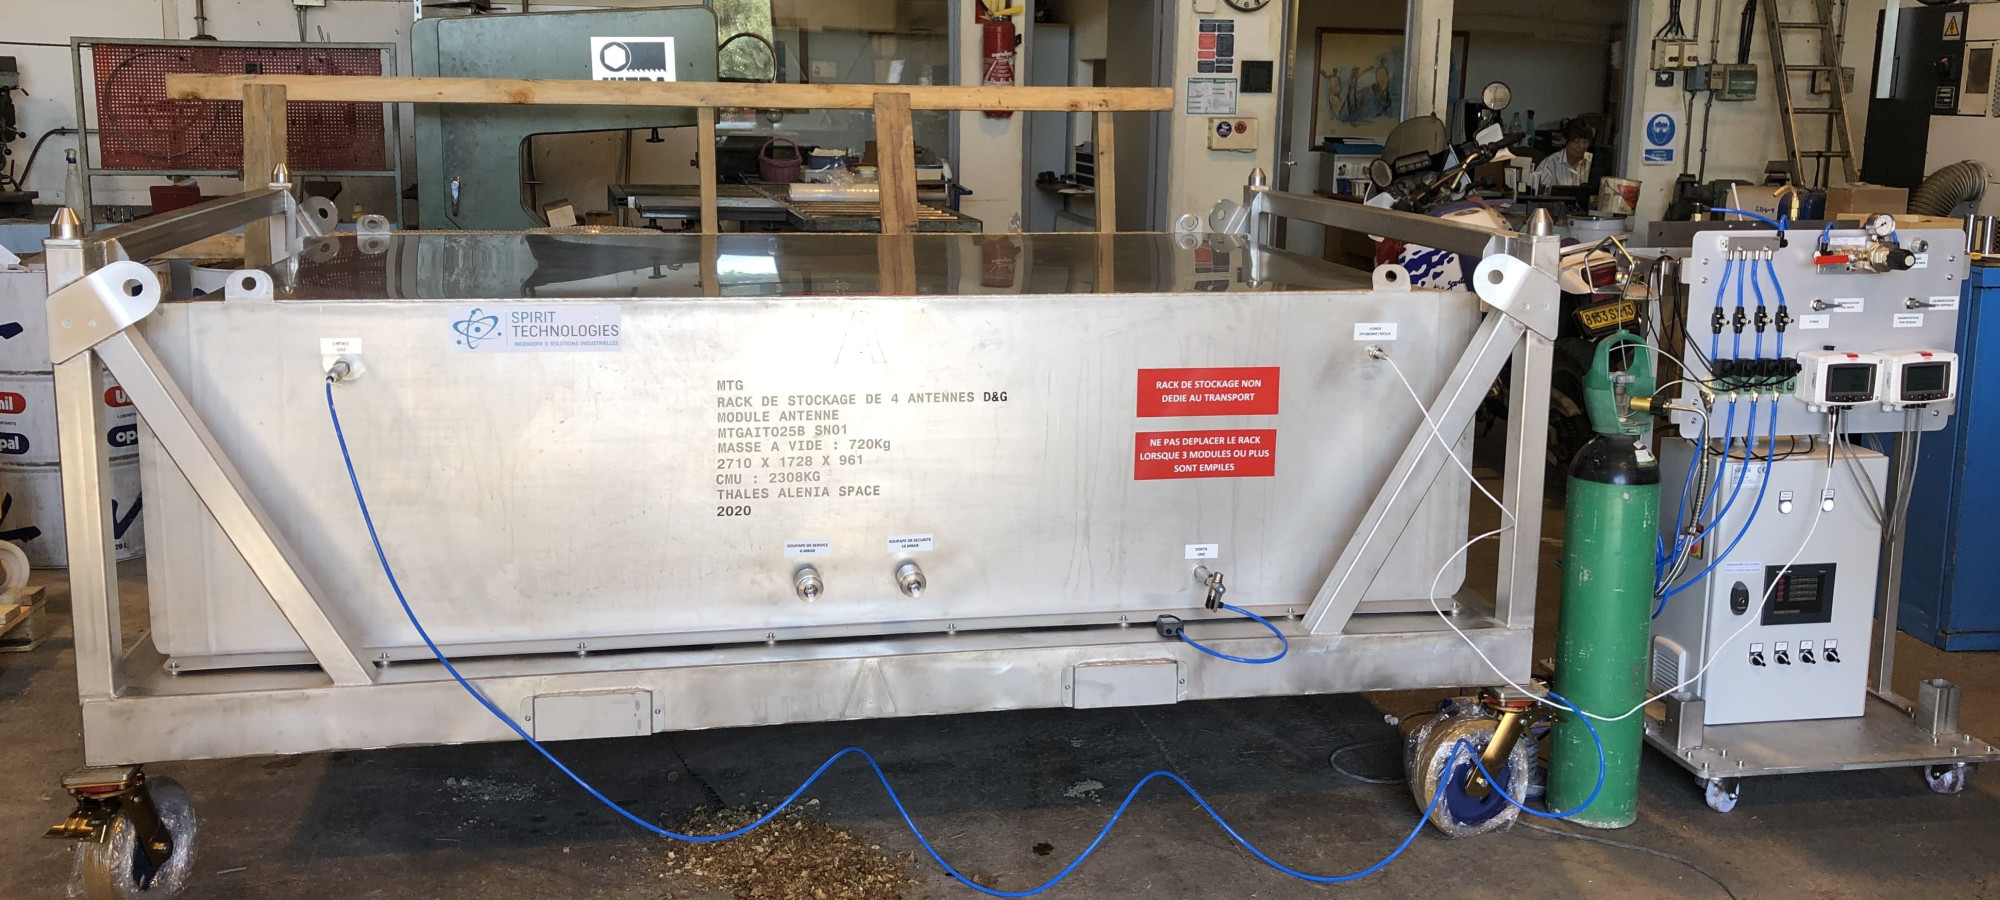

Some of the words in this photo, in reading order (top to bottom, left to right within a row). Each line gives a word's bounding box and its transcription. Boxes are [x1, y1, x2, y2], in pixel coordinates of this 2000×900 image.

[511, 311, 556, 324] SPIRIT
[512, 324, 619, 338] TECHNOLOGIES
[717, 380, 744, 391] MTG
[1156, 380, 1179, 389] RACK
[1181, 380, 1192, 389] DE
[1194, 379, 1240, 389] STOCKAGE
[1241, 379, 1262, 388] NON
[115, 389, 131, 404] U
[717, 396, 753, 408] RACK
[761, 395, 779, 407] DE
[788, 394, 856, 406] STOCKAGE
[865, 393, 882, 404] DE
[891, 393, 899, 404] 4
[907, 392, 975, 403] ANTENNES
[983, 391, 1008, 402] D&G
[1161, 394, 1187, 403] DEDIE
[1188, 394, 1202, 402] AU
[1204, 392, 1256, 402] TRANSPORT
[717, 411, 770, 423] MODULE
[779, 409, 840, 422] ANTENNE
[115, 430, 139, 444] op
[1149, 438, 1161, 447] NE
[1163, 438, 1180, 447] PAS
[1182, 436, 1225, 446] DEPLACER
[1226, 436, 1236, 445] LE
[1238, 435, 1261, 444] RACK
[717, 441, 762, 453] MASSE
[770, 441, 780, 452] A
[789, 439, 823, 451] VIDE
[833, 441, 839, 451] :
[849, 438, 891, 452] 720Kg
[716, 457, 752, 469] 2710
[761, 457, 770, 468] X
[779, 456, 813, 467] 1728
[822, 455, 831, 466] X
[839, 454, 863, 466] 961
[1140, 451, 1180, 461] LORSQUE
[1181, 451, 1188, 459] 3
[1189, 449, 1232, 459] MODULES
[1233, 449, 1247, 458] OU
[1248, 449, 1270, 458] PLUS
[1174, 464, 1198, 473] SONT
[1199, 463, 1235, 472] EMPILES
[716, 473, 742, 485] CMU
[753, 475, 758, 484] :
[769, 471, 821, 484] 2308KG
[717, 488, 770, 500] THALES
[778, 486, 830, 498] ALENIA
[838, 485, 881, 497] SPACE
[716, 505, 752, 517] 2020
